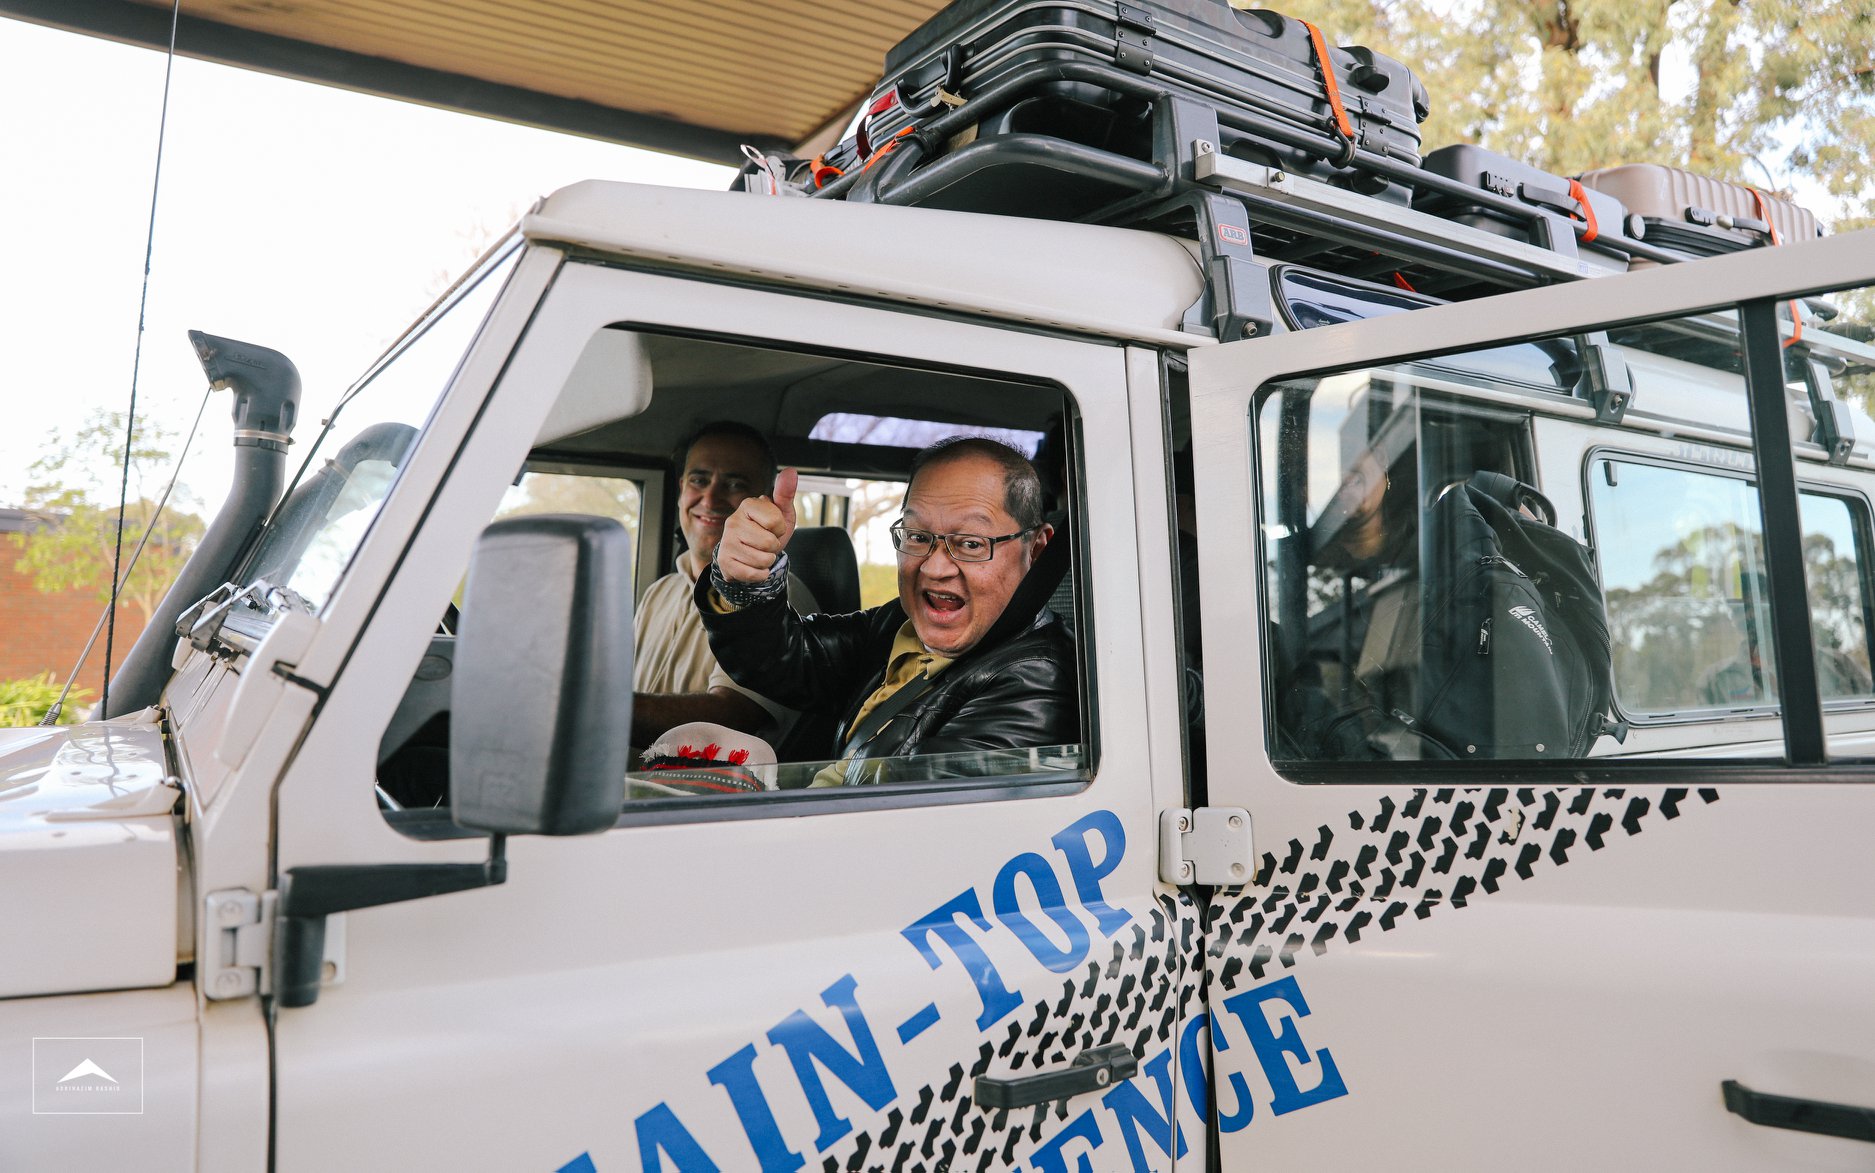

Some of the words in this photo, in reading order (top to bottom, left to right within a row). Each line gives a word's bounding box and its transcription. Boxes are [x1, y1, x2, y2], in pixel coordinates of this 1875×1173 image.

[1223, 227, 1244, 241] ARB
[1527, 615, 1549, 640] CAMEL
[556, 810, 1132, 1173] AIN-TOP
